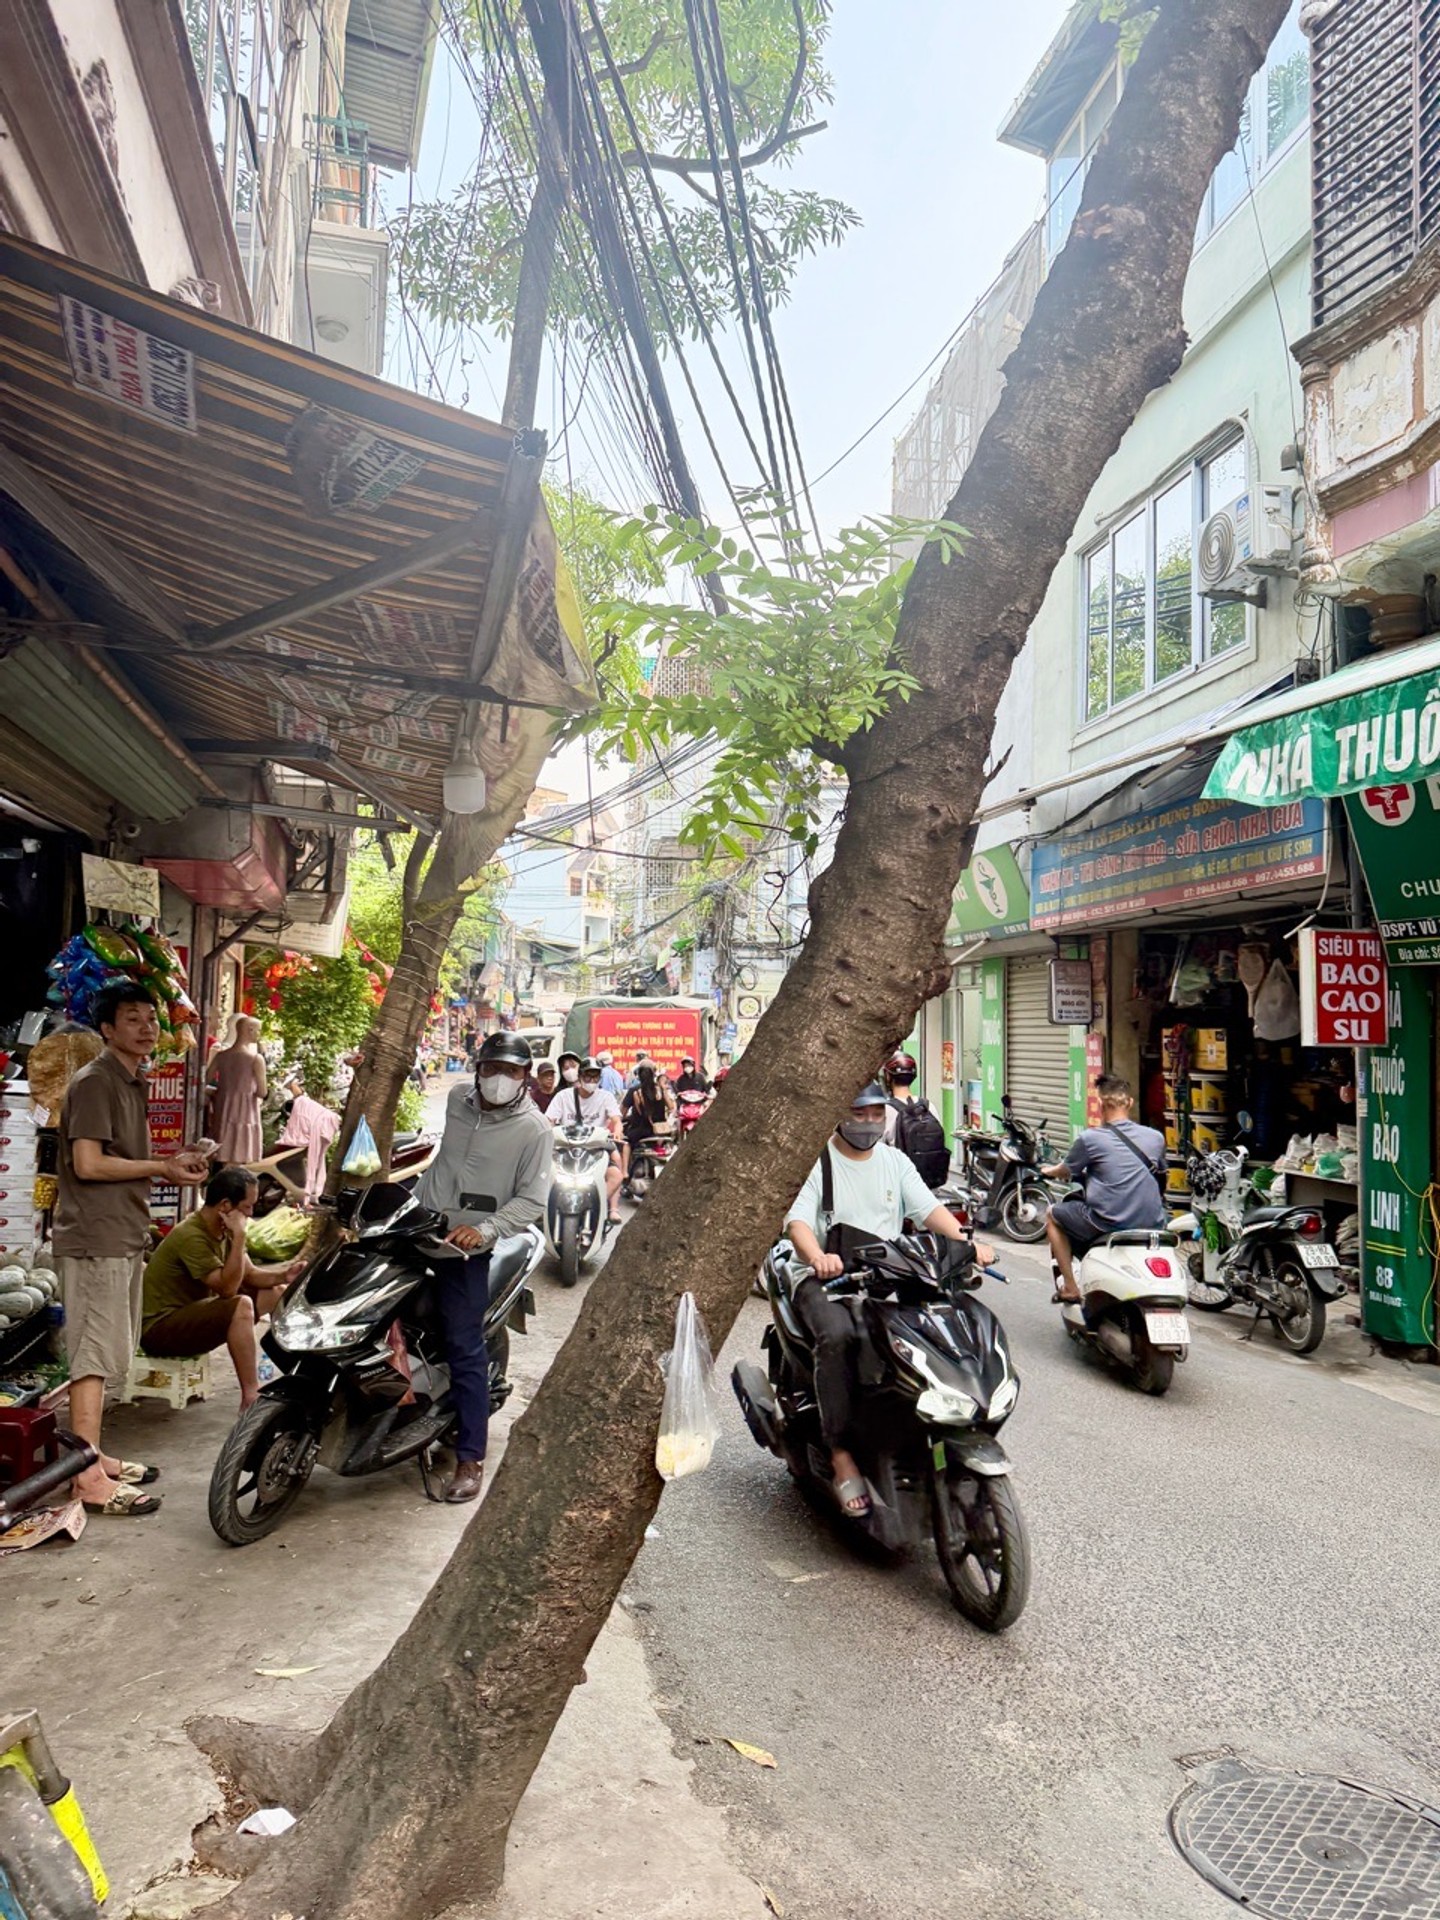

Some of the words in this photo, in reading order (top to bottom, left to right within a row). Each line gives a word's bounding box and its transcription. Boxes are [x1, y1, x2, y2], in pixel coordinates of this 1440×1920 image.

[1226, 724, 1313, 797] NHÀ
[1319, 935, 1353, 957] SIÊU
[1357, 939, 1381, 961] THỊ
[1320, 962, 1380, 986] BAO
[1320, 989, 1382, 1013] CAO
[1333, 1018, 1370, 1041] SU
[1370, 1043, 1406, 1097] THUỐC
[1372, 1111, 1400, 1163] BẢO
[1370, 1189, 1400, 1231] LINH
